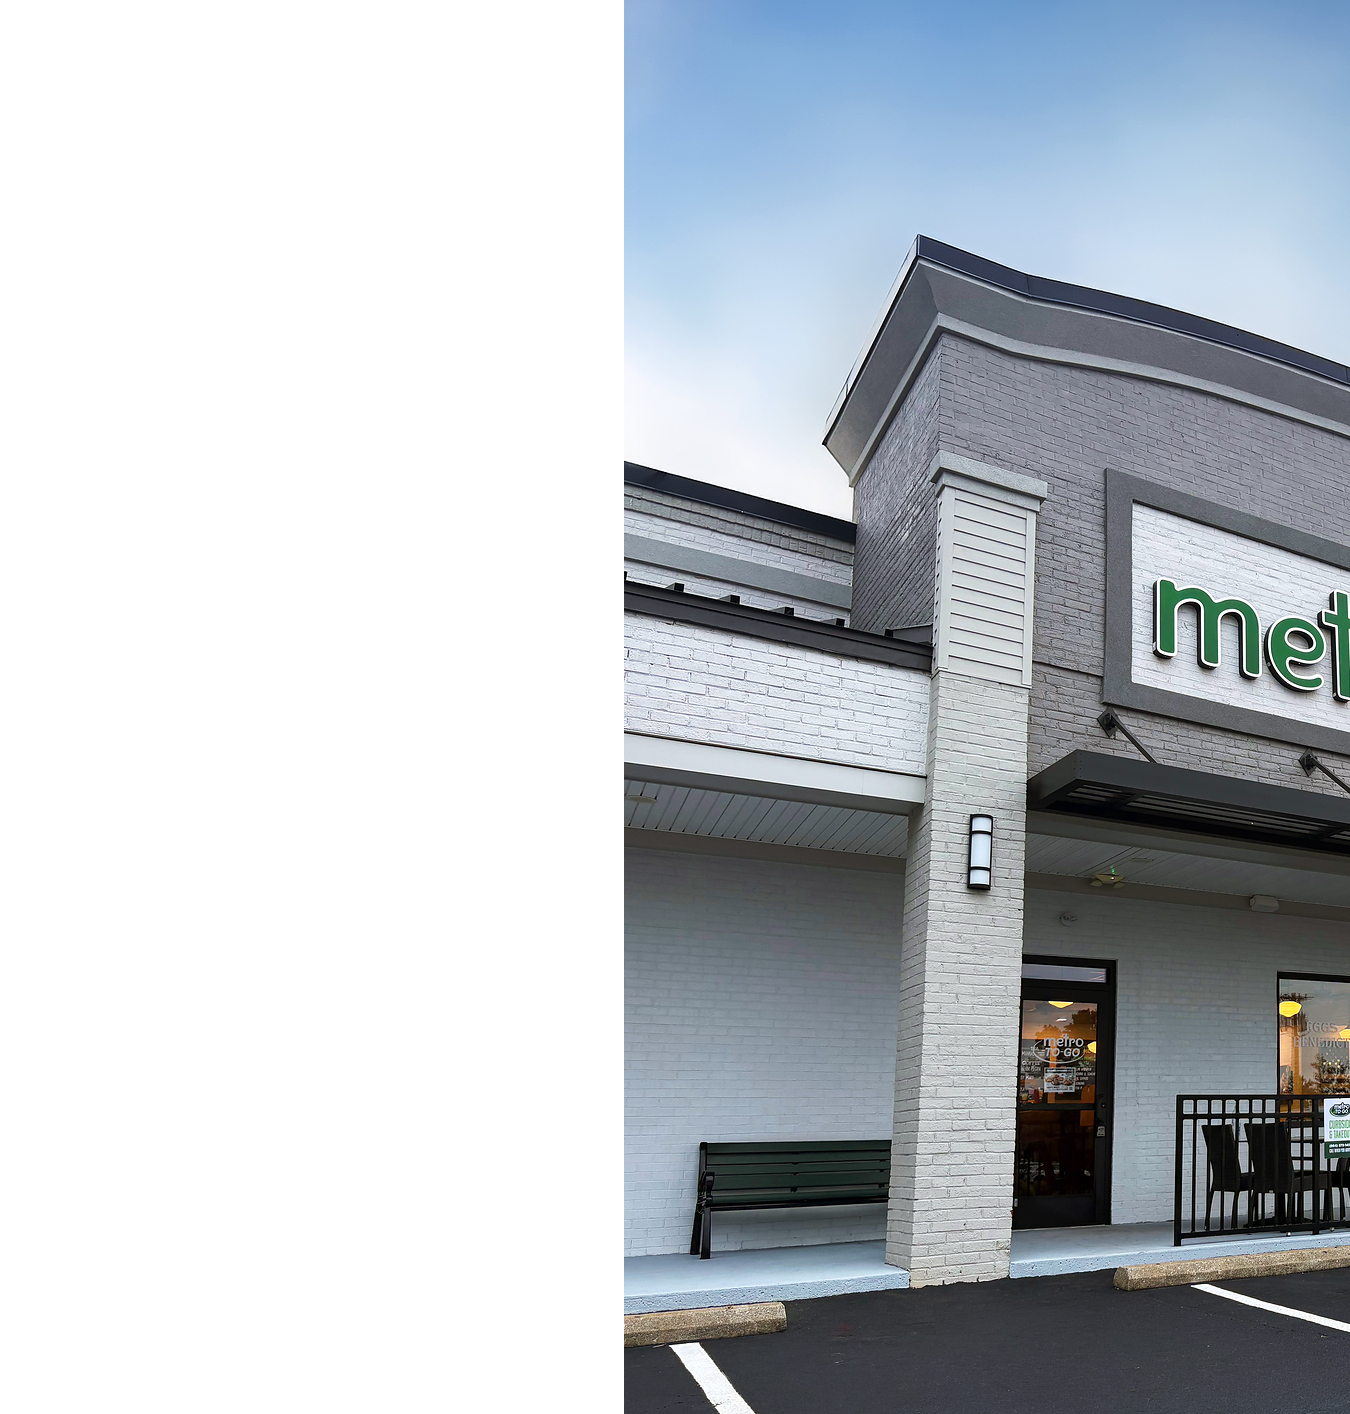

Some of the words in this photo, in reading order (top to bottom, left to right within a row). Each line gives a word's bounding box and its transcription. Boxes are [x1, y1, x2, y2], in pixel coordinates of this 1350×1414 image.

[1043, 1033, 1084, 1047] metro
[1293, 1036, 1350, 1048] BENEDICT
[1045, 1047, 1081, 1057] TO-GO
